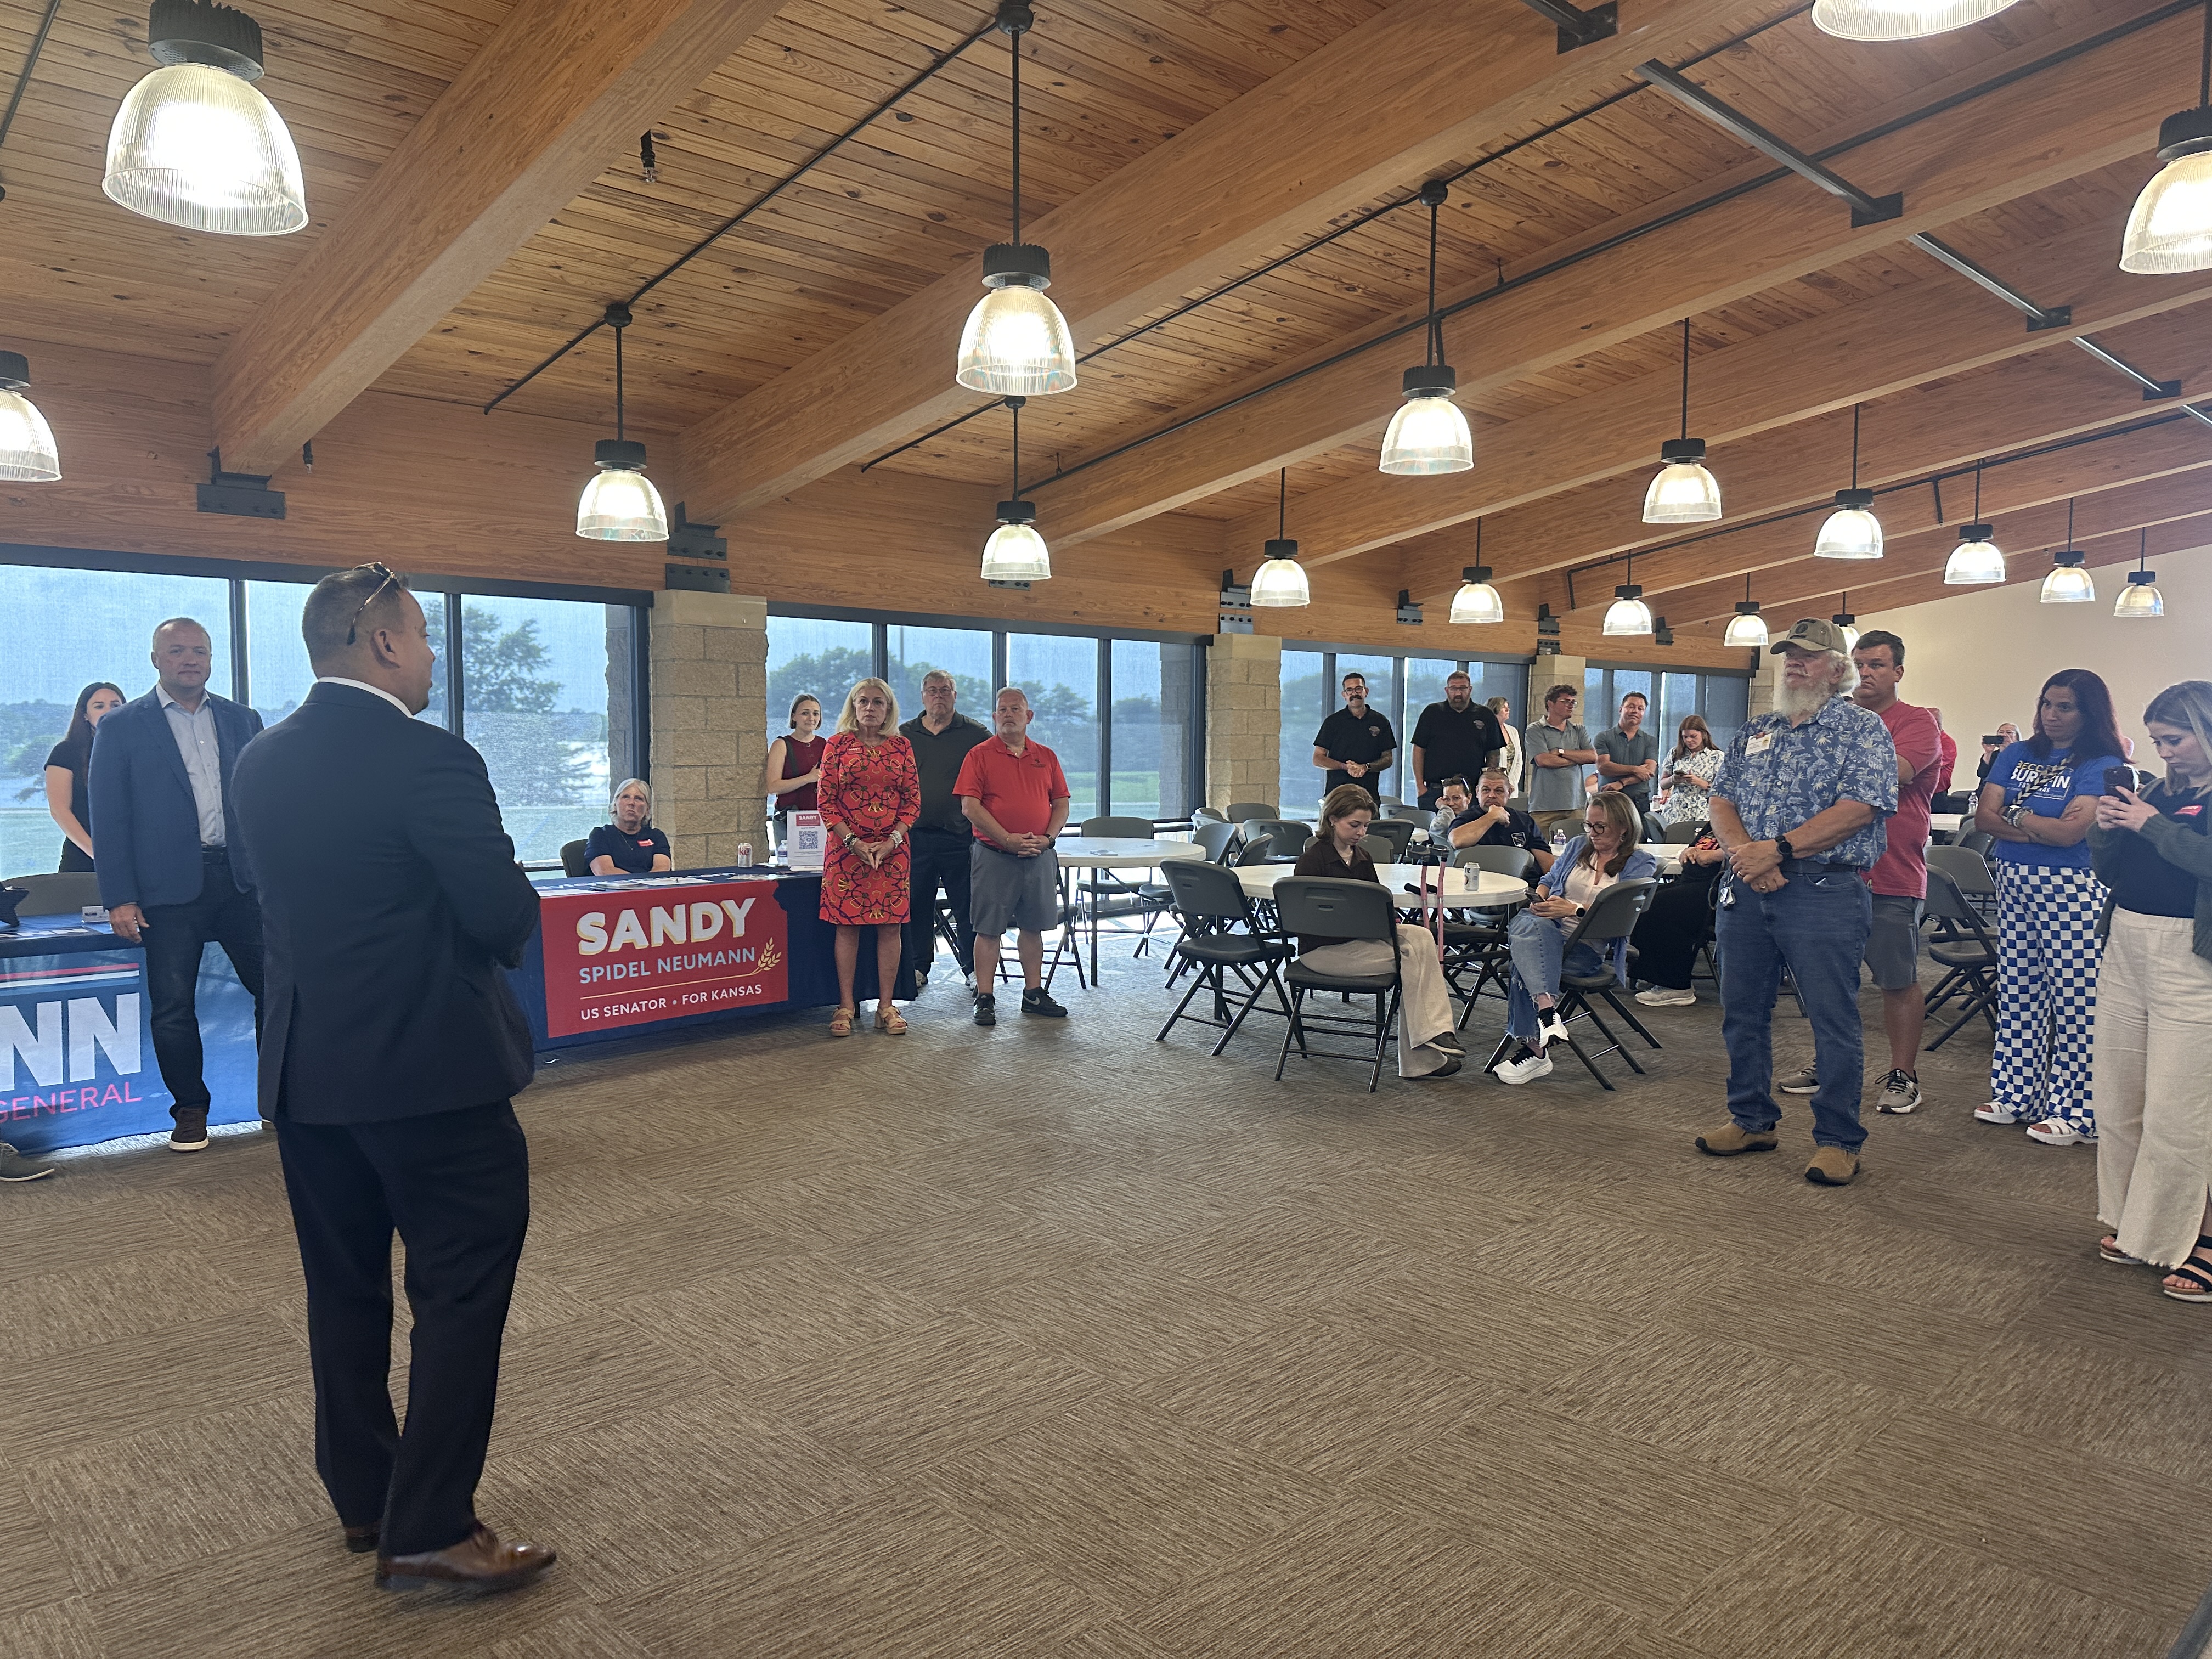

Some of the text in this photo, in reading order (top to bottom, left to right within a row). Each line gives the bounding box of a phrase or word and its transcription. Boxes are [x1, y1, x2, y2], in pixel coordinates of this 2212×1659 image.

[2010, 768, 2071, 788] BURIN
[2016, 760, 2052, 773] BECC
[577, 898, 756, 956] SANDY
[579, 947, 755, 984] SPIDEL NEUMANN
[581, 984, 762, 1020] US SENATOR FOR KANSAS
[0, 992, 141, 1092] NN
